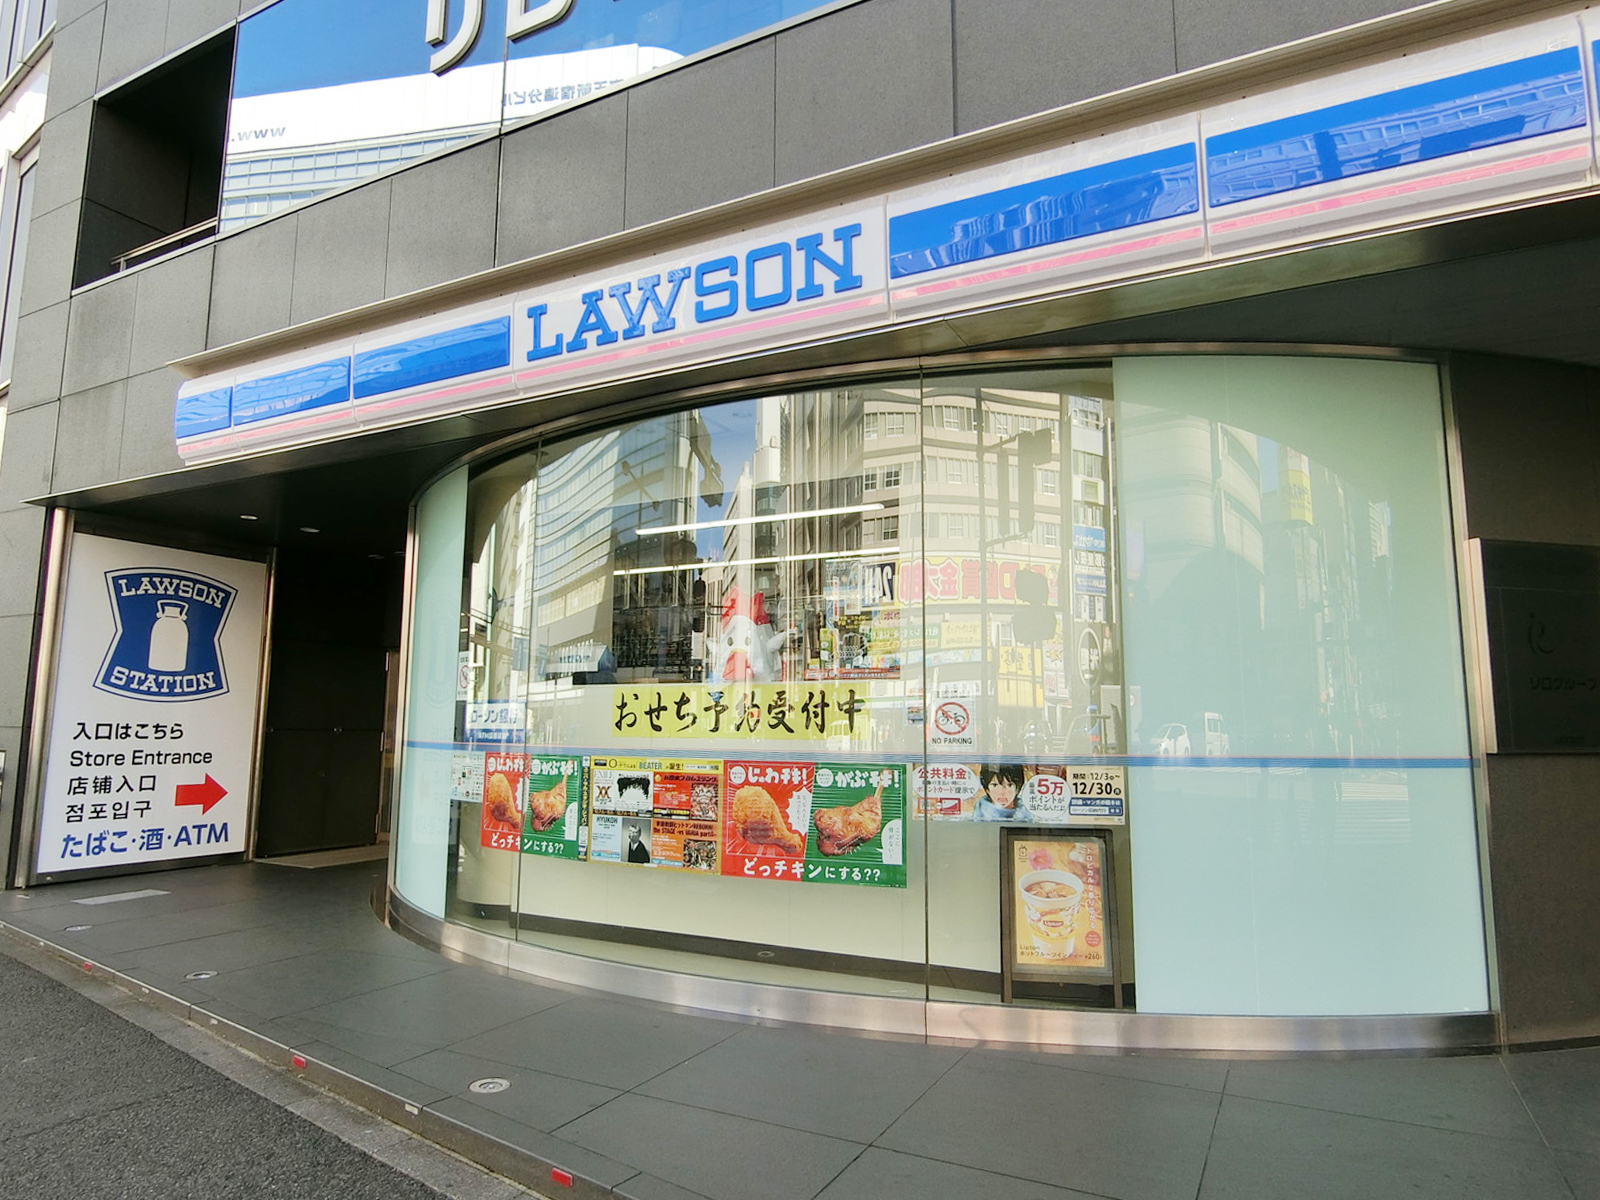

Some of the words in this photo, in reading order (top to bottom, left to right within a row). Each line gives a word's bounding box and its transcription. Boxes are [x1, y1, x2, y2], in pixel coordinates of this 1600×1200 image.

[526, 223, 863, 362] LAWSON
[118, 577, 226, 608] LAWSON
[110, 666, 216, 693] STATION
[471, 708, 518, 724] ローソン銀行
[614, 689, 866, 734] おせち予約受付中
[73, 722, 184, 740] 入口はこちら
[70, 750, 126, 767] Store
[131, 750, 213, 766] Entrance
[65, 800, 152, 823] 점포입구
[61, 822, 229, 859] たばこ・酒・ATM
[743, 857, 881, 881] どっチキンにする??
